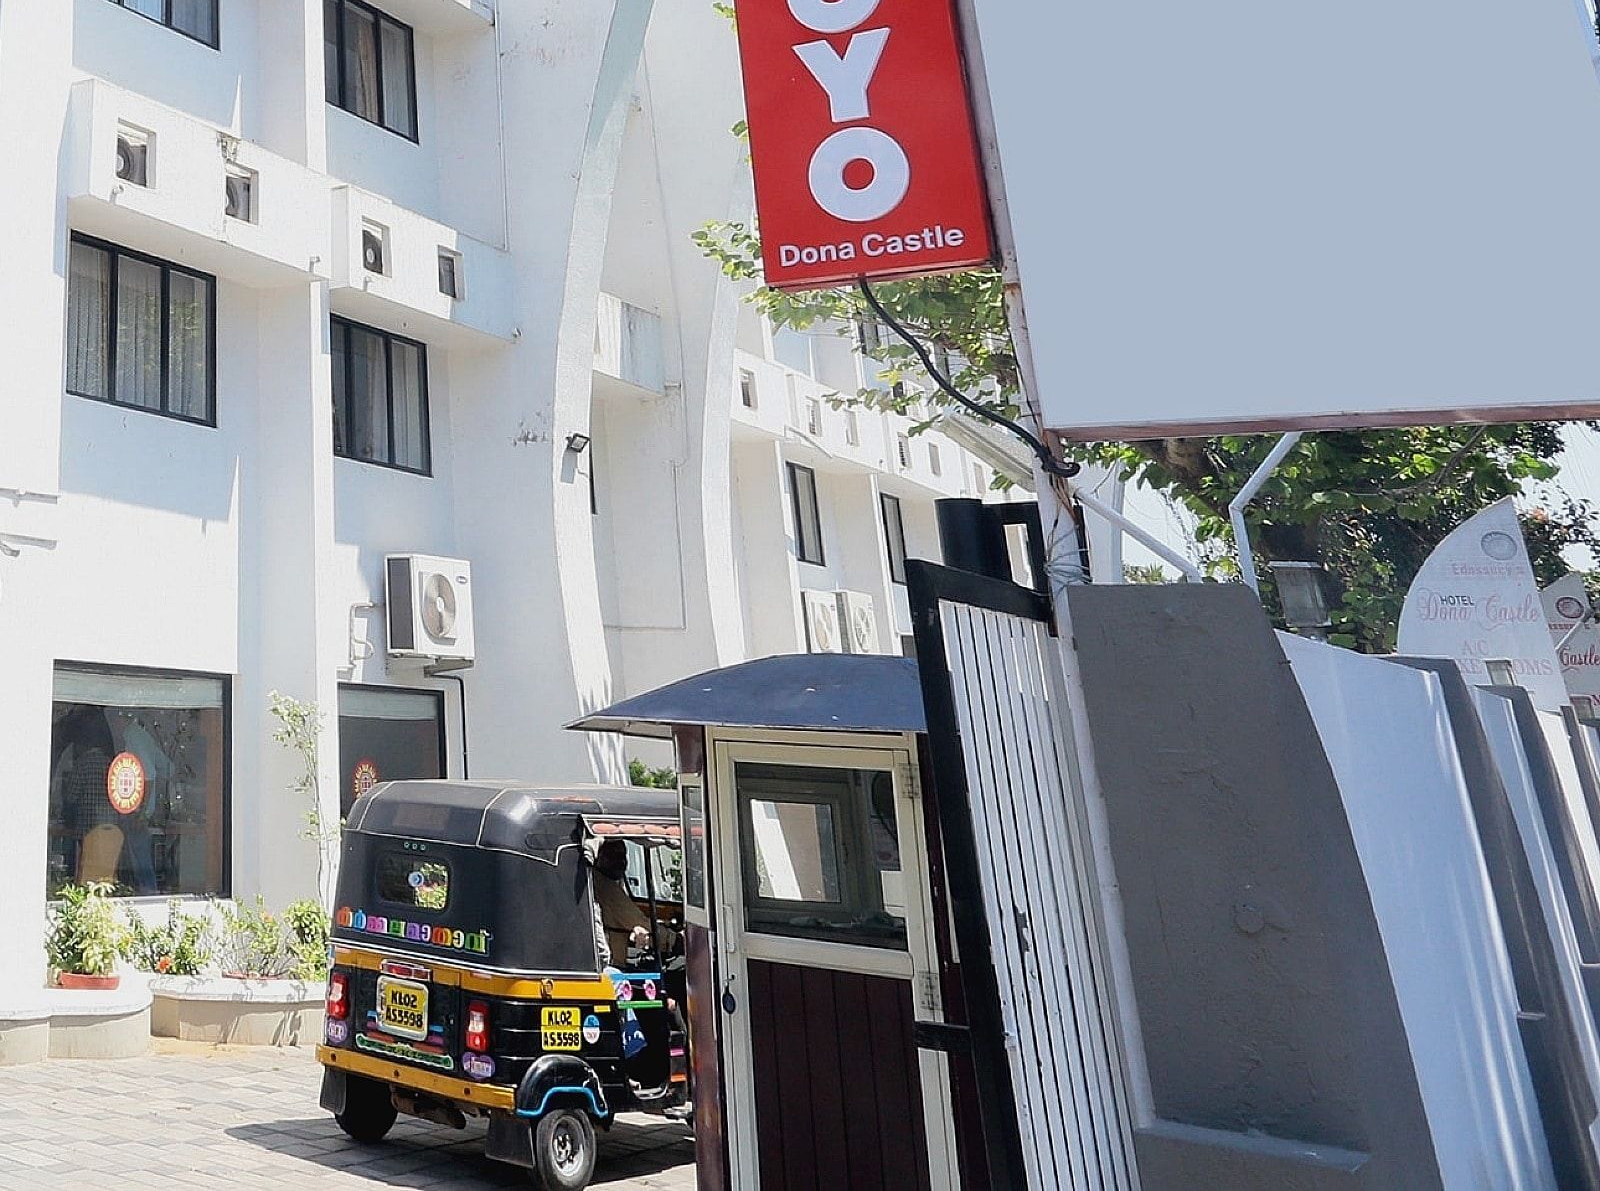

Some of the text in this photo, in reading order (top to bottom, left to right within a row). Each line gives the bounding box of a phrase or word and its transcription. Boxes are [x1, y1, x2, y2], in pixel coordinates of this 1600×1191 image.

[780, 224, 965, 268] Dona Castle
[1440, 595, 1475, 606] HOTEL
[391, 990, 418, 1009] KL02
[547, 1010, 573, 1026] KL02
